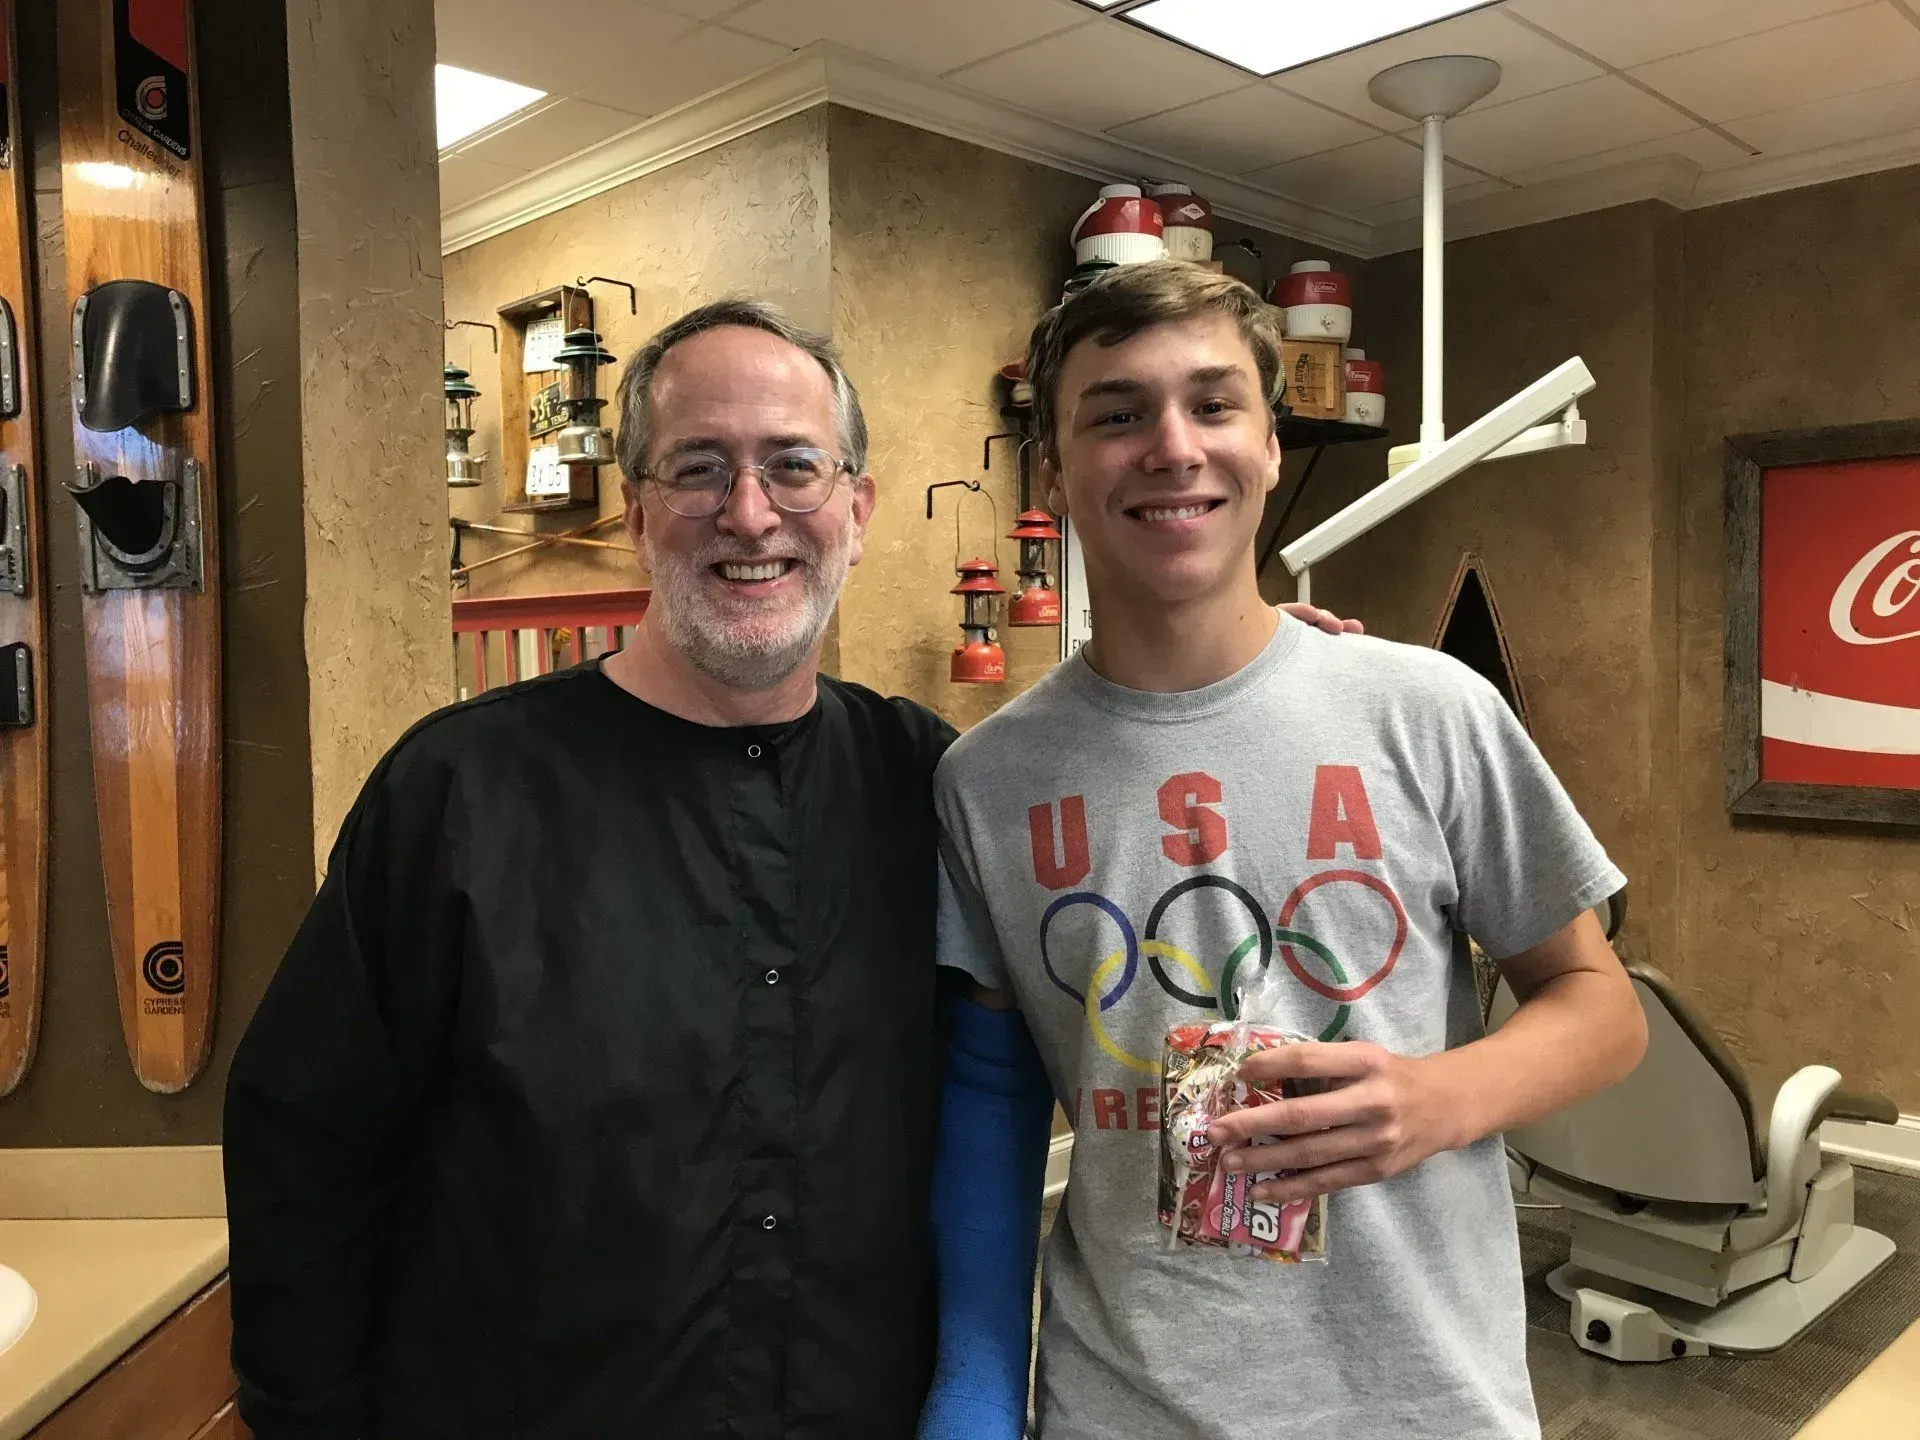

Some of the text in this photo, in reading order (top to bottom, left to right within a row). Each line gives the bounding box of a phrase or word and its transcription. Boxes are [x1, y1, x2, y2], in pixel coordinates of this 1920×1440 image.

[152, 129, 187, 156] GARDENS
[144, 997, 187, 1006] CYPRESS
[144, 1006, 186, 1015] GARDENS
[1221, 1173, 1236, 1237] CLASSIC BUBBLE
